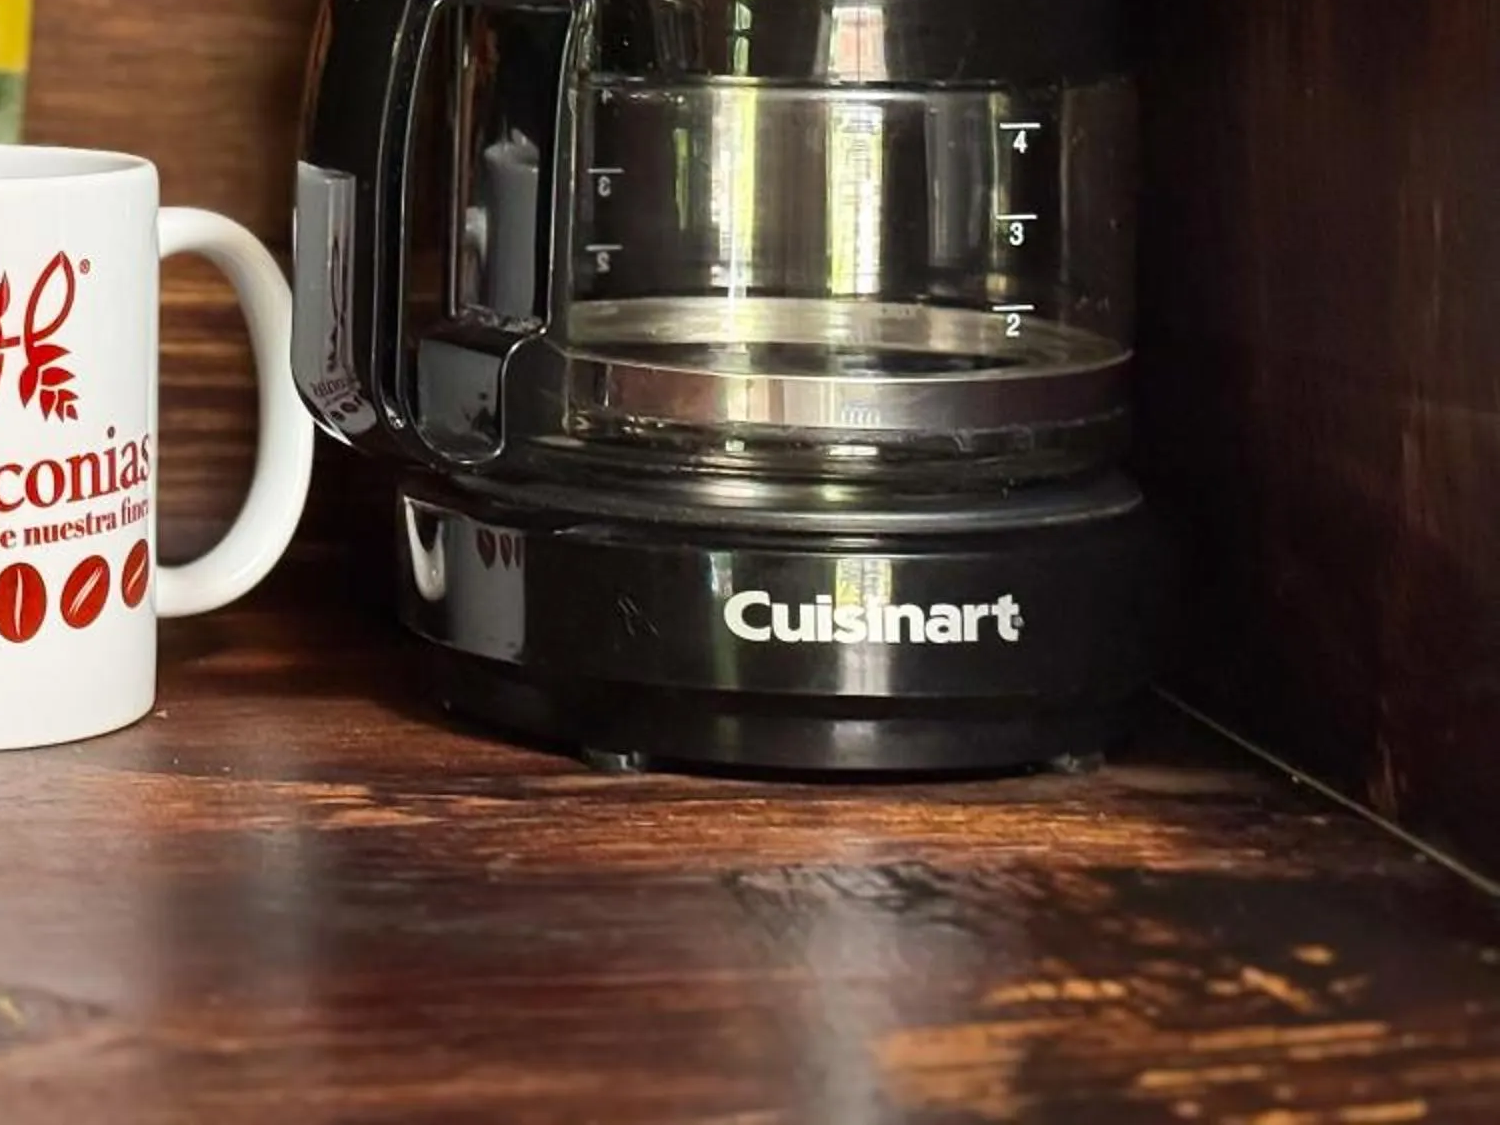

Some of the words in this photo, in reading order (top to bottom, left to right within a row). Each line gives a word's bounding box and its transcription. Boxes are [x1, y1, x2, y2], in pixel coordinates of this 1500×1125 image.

[1013, 130, 1028, 154] 4
[1009, 222, 1024, 246] 3
[1006, 313, 1021, 337] 2
[23, 512, 117, 546] nuestra
[723, 590, 1020, 644] Cuisinart
